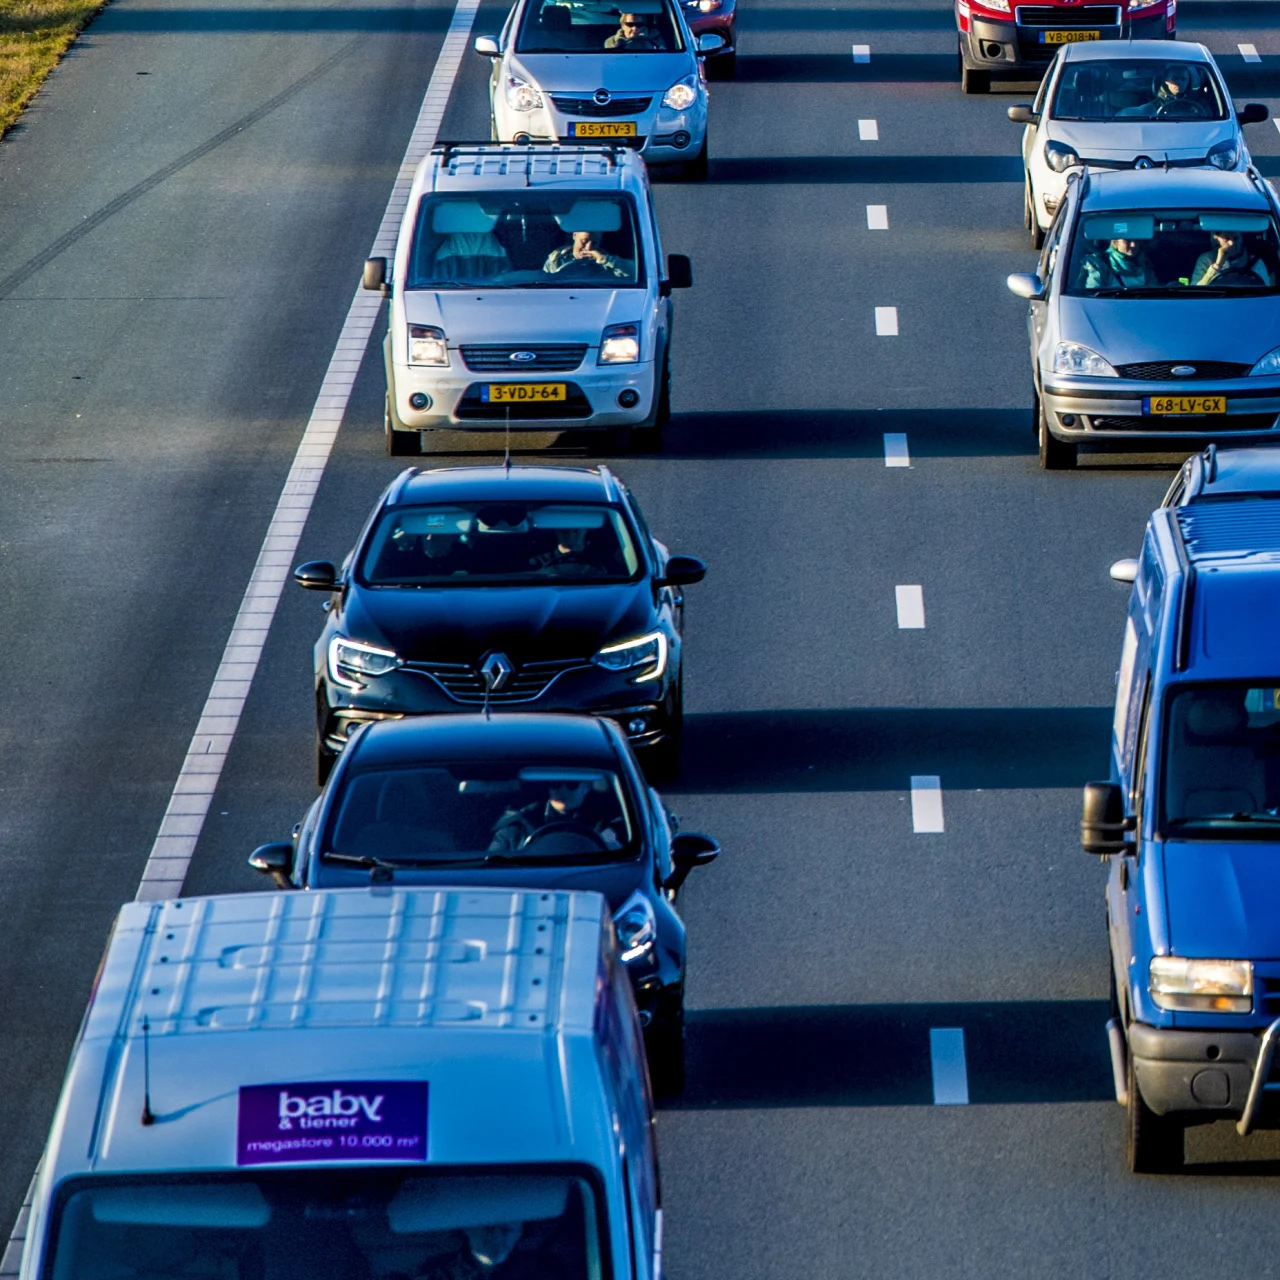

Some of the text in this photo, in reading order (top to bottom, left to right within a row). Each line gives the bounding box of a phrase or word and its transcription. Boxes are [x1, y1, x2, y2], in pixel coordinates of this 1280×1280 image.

[579, 123, 630, 135] 85-XTV-3
[494, 387, 559, 400] 3-VDJ-64
[1155, 399, 1221, 412] 68-LV-GX
[279, 1090, 384, 1121] baby
[278, 1116, 359, 1130] & tiener
[247, 1136, 333, 1153] megastore
[339, 1135, 393, 1148] 10.000
